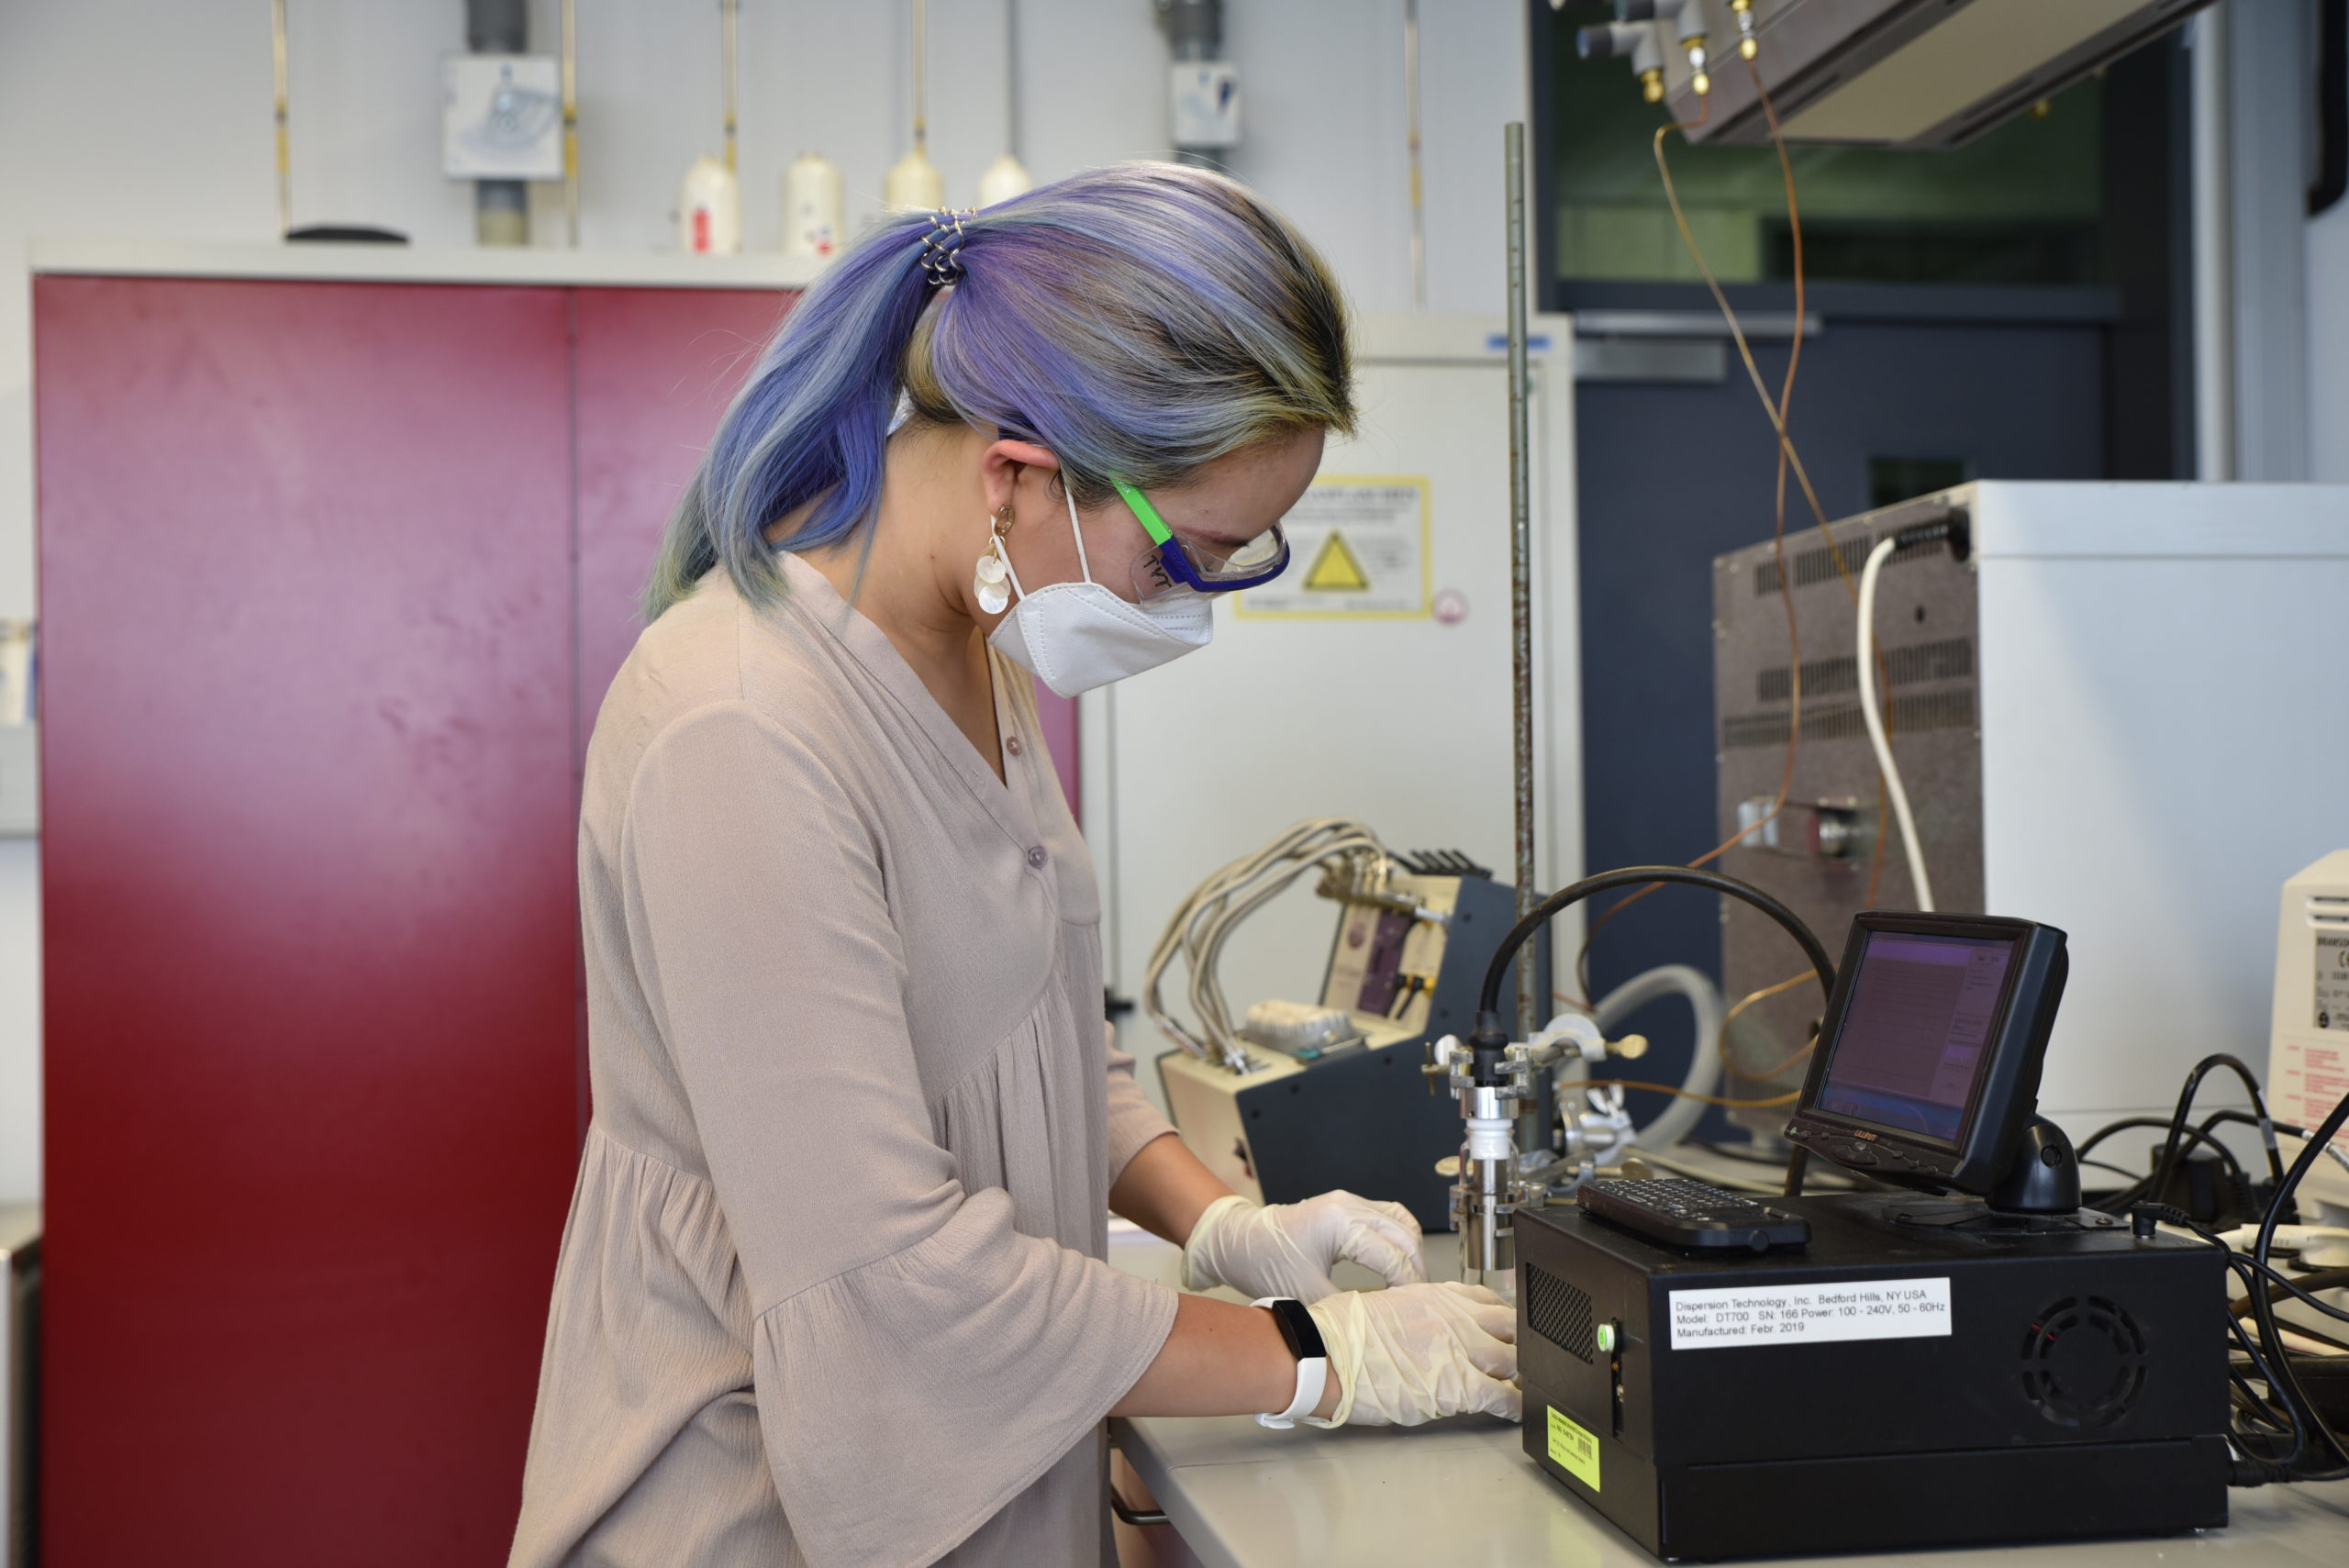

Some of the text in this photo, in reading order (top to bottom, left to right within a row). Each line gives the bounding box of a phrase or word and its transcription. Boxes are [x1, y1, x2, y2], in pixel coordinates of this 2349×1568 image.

[1675, 1301, 1728, 1313] Dispersion
[1819, 1293, 1856, 1304] Bedford
[1860, 1292, 1883, 1303] Hills,
[1887, 1291, 1901, 1301] NY
[1904, 1289, 1927, 1300] USA
[1676, 1315, 1708, 1324] Model:
[1716, 1311, 1749, 1322] DT700
[1781, 1309, 1798, 1319] 166
[1839, 1306, 1856, 1316] 100
[1866, 1304, 1895, 1315] 240V,
[1898, 1303, 1910, 1313] 50
[1919, 1302, 1945, 1312] 60Hz
[1676, 1326, 1747, 1338] Manufactured:
[1780, 1321, 1805, 1332] 2019
